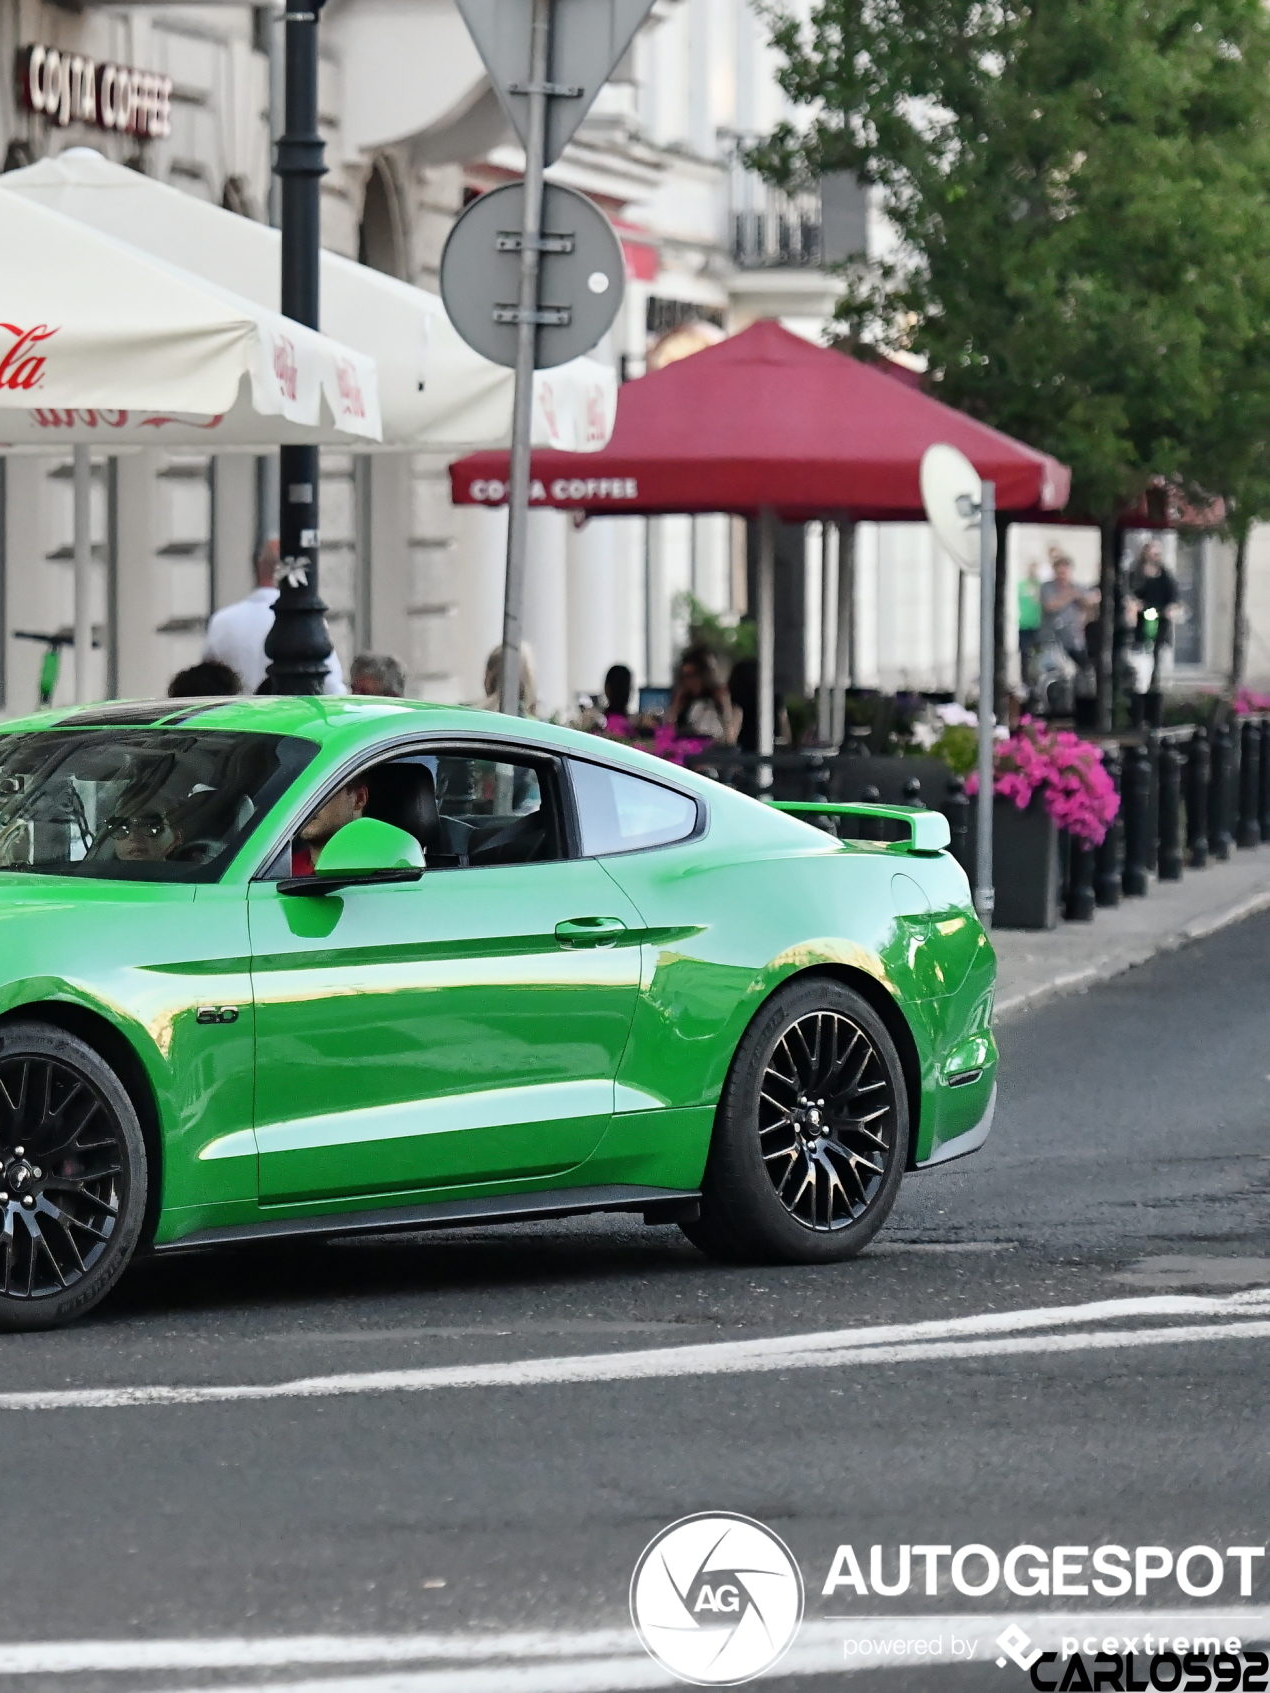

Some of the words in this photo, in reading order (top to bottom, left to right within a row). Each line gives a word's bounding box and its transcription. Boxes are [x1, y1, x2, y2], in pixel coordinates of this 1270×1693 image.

[29, 43, 96, 127] COSTA
[101, 65, 173, 138] COFFEE
[469, 479, 547, 501] COA
[551, 477, 639, 500] COFFEE
[197, 1005, 239, 1024] 5.0
